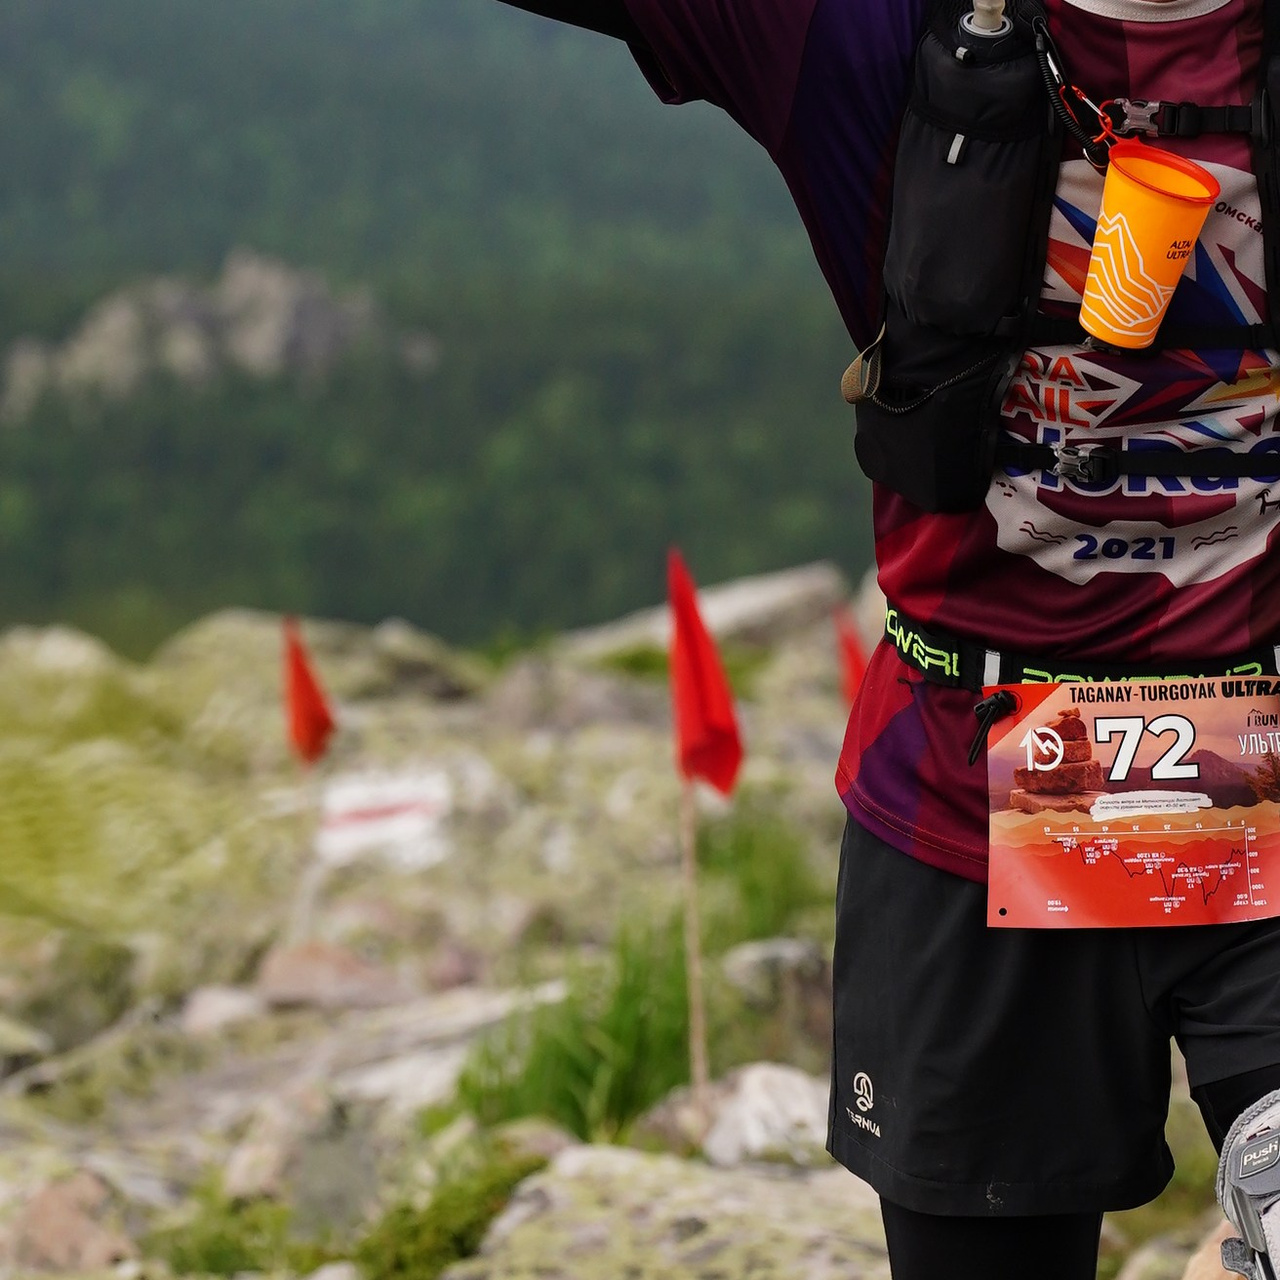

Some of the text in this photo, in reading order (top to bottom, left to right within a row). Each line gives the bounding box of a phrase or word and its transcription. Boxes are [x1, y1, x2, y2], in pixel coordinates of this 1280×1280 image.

[1214, 201, 1264, 234] Омска
[1073, 533, 1176, 560] 2021
[885, 609, 961, 677] OWER
[1069, 682, 1217, 704] TAGANAY-TURGOYAK
[1094, 713, 1200, 782] 72
[1243, 1140, 1278, 1166] push
